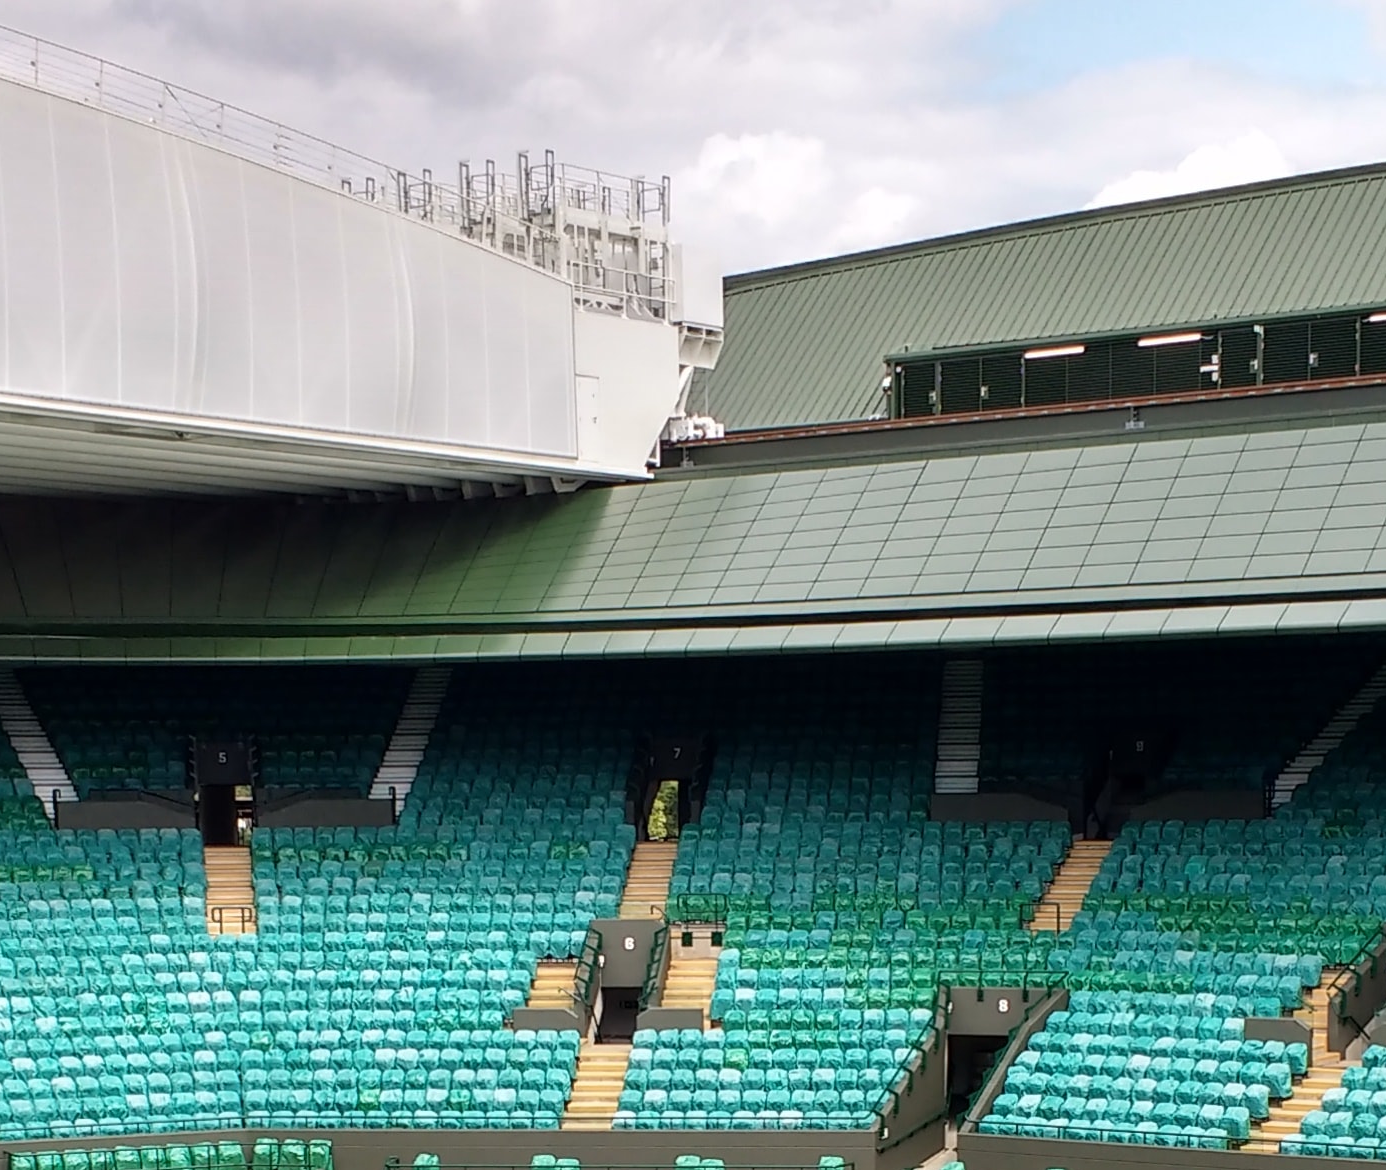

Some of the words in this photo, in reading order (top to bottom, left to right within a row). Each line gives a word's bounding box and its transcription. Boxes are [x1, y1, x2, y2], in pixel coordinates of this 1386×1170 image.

[218, 751, 227, 764] 5
[673, 746, 682, 759] 7
[624, 937, 635, 951] 6
[998, 999, 1009, 1012] 8
